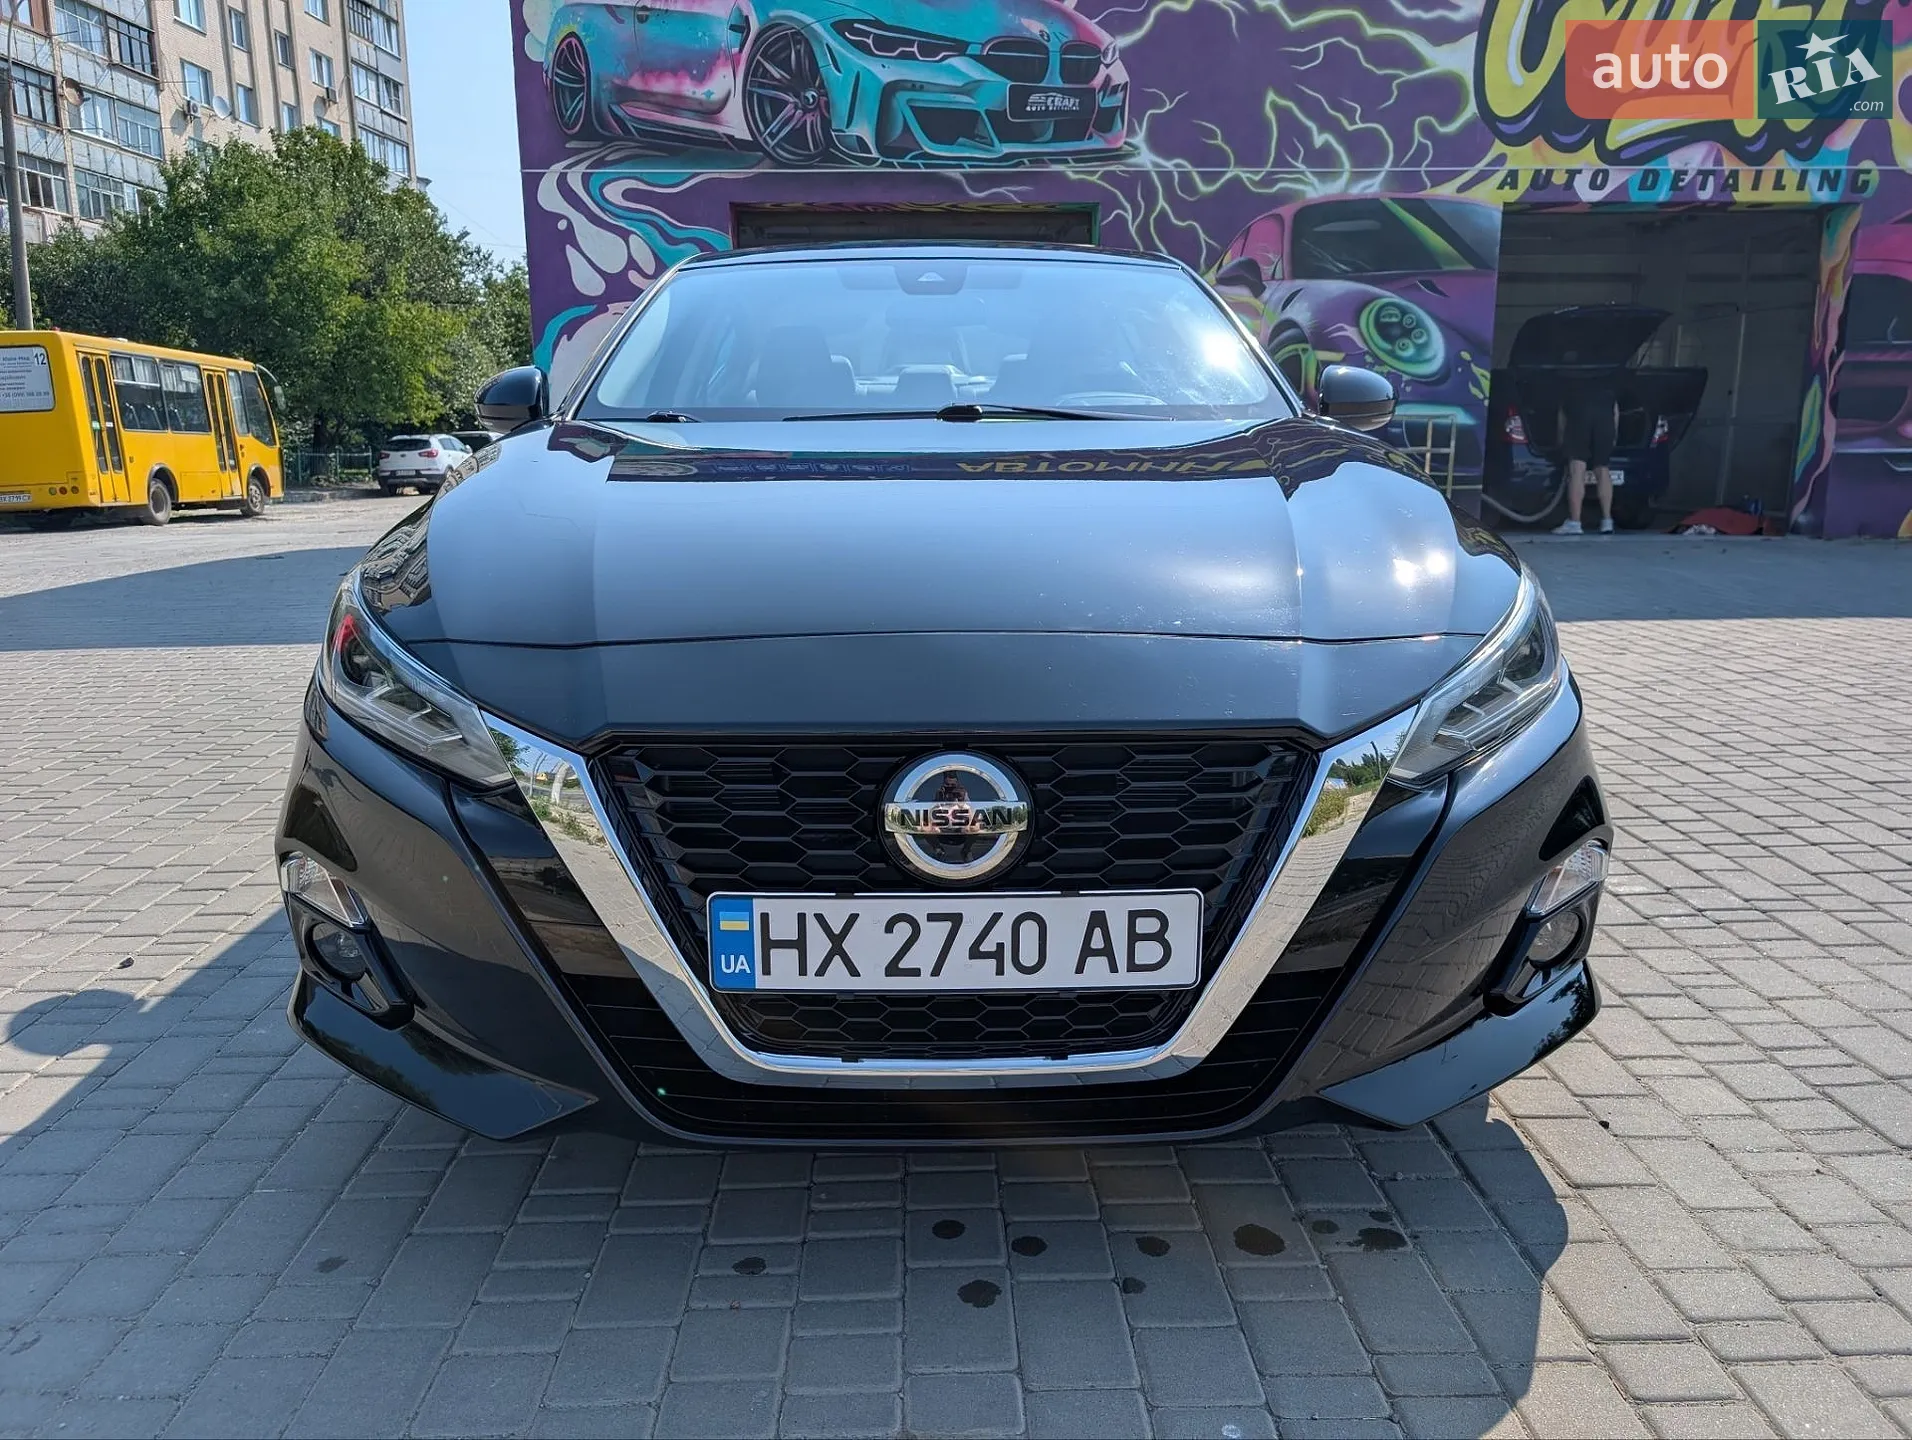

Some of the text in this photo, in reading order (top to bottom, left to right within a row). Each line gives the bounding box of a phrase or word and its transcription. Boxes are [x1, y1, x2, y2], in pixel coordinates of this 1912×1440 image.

[1496, 168, 1873, 194] AUTO DETAILING
[34, 352, 47, 366] 12
[899, 808, 1013, 828] NISSAN
[759, 908, 1174, 978] HX 2740 AB
[720, 953, 752, 975] UA
